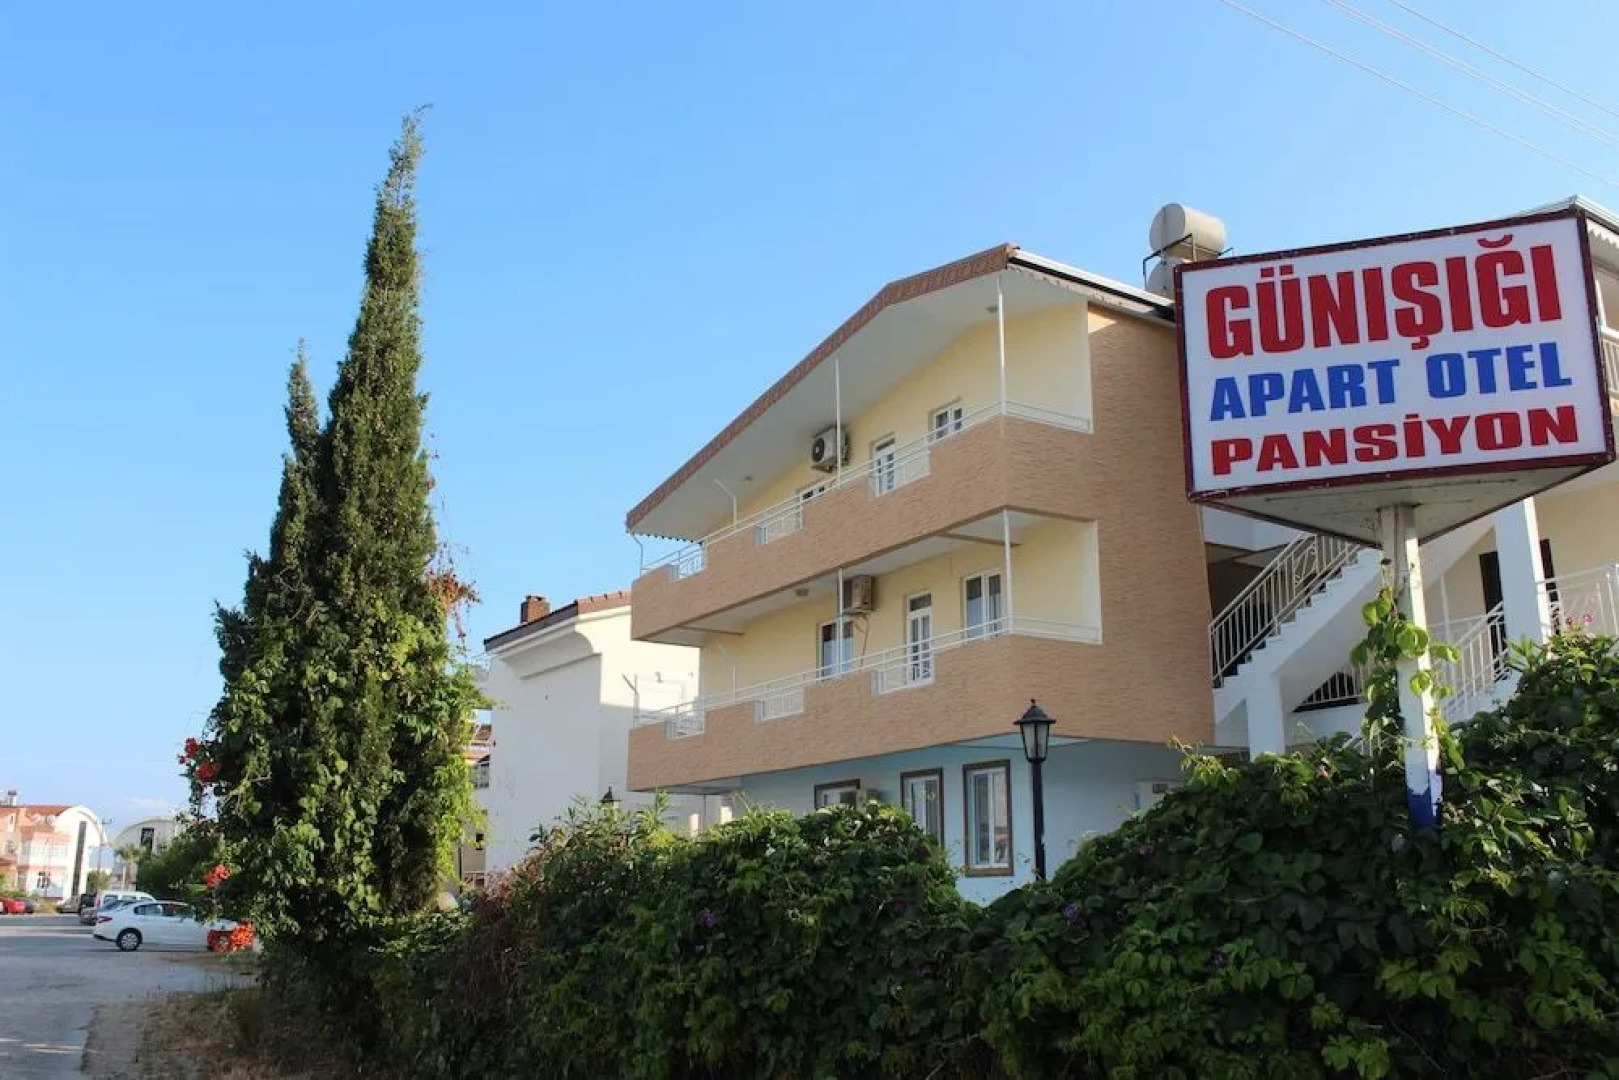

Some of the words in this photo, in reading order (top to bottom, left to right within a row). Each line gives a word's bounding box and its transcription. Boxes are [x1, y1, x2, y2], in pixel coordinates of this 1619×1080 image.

[1206, 233, 1562, 359] GÜNIŞIĞI
[1211, 359, 1400, 421] APART
[1425, 342, 1573, 399] OTEL
[1211, 405, 1578, 476] PANSİYON
